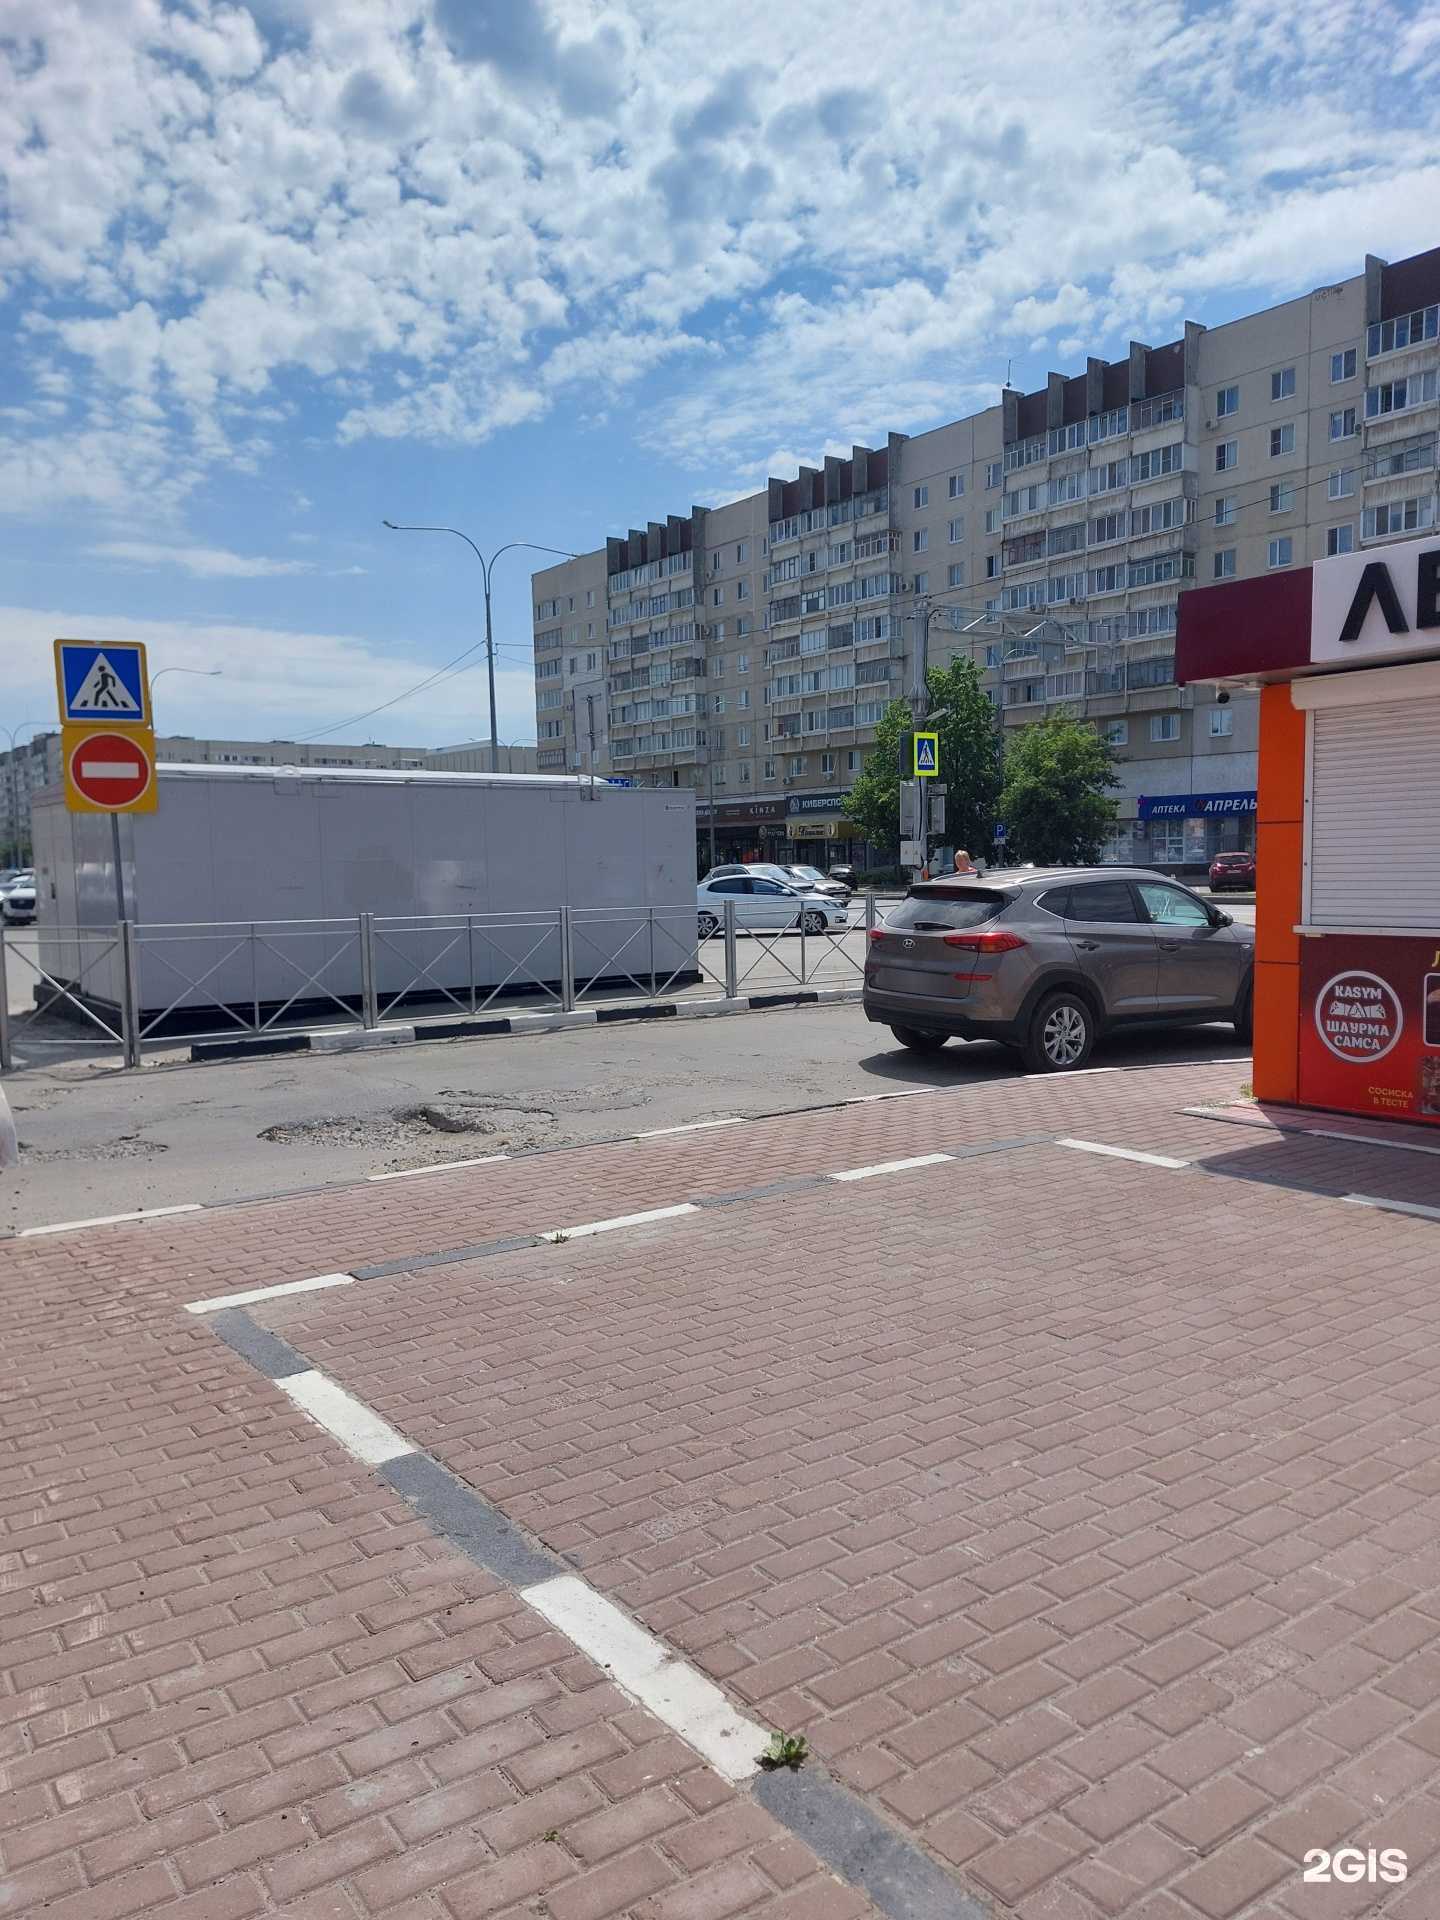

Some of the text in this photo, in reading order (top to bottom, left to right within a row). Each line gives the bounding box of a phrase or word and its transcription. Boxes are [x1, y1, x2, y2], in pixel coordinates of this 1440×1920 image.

[802, 797, 842, 809] КИБЕРСПО
[1151, 799, 1257, 815] АПТЕКА АПРЕЛЬ
[1335, 985, 1383, 1000] KASYM
[1326, 1020, 1390, 1037] ШАУРМА
[1334, 1035, 1381, 1050] САМСА
[1368, 1086, 1414, 1099] СОСИСКА
[1381, 1097, 1409, 1109] ТЕСТЕ
